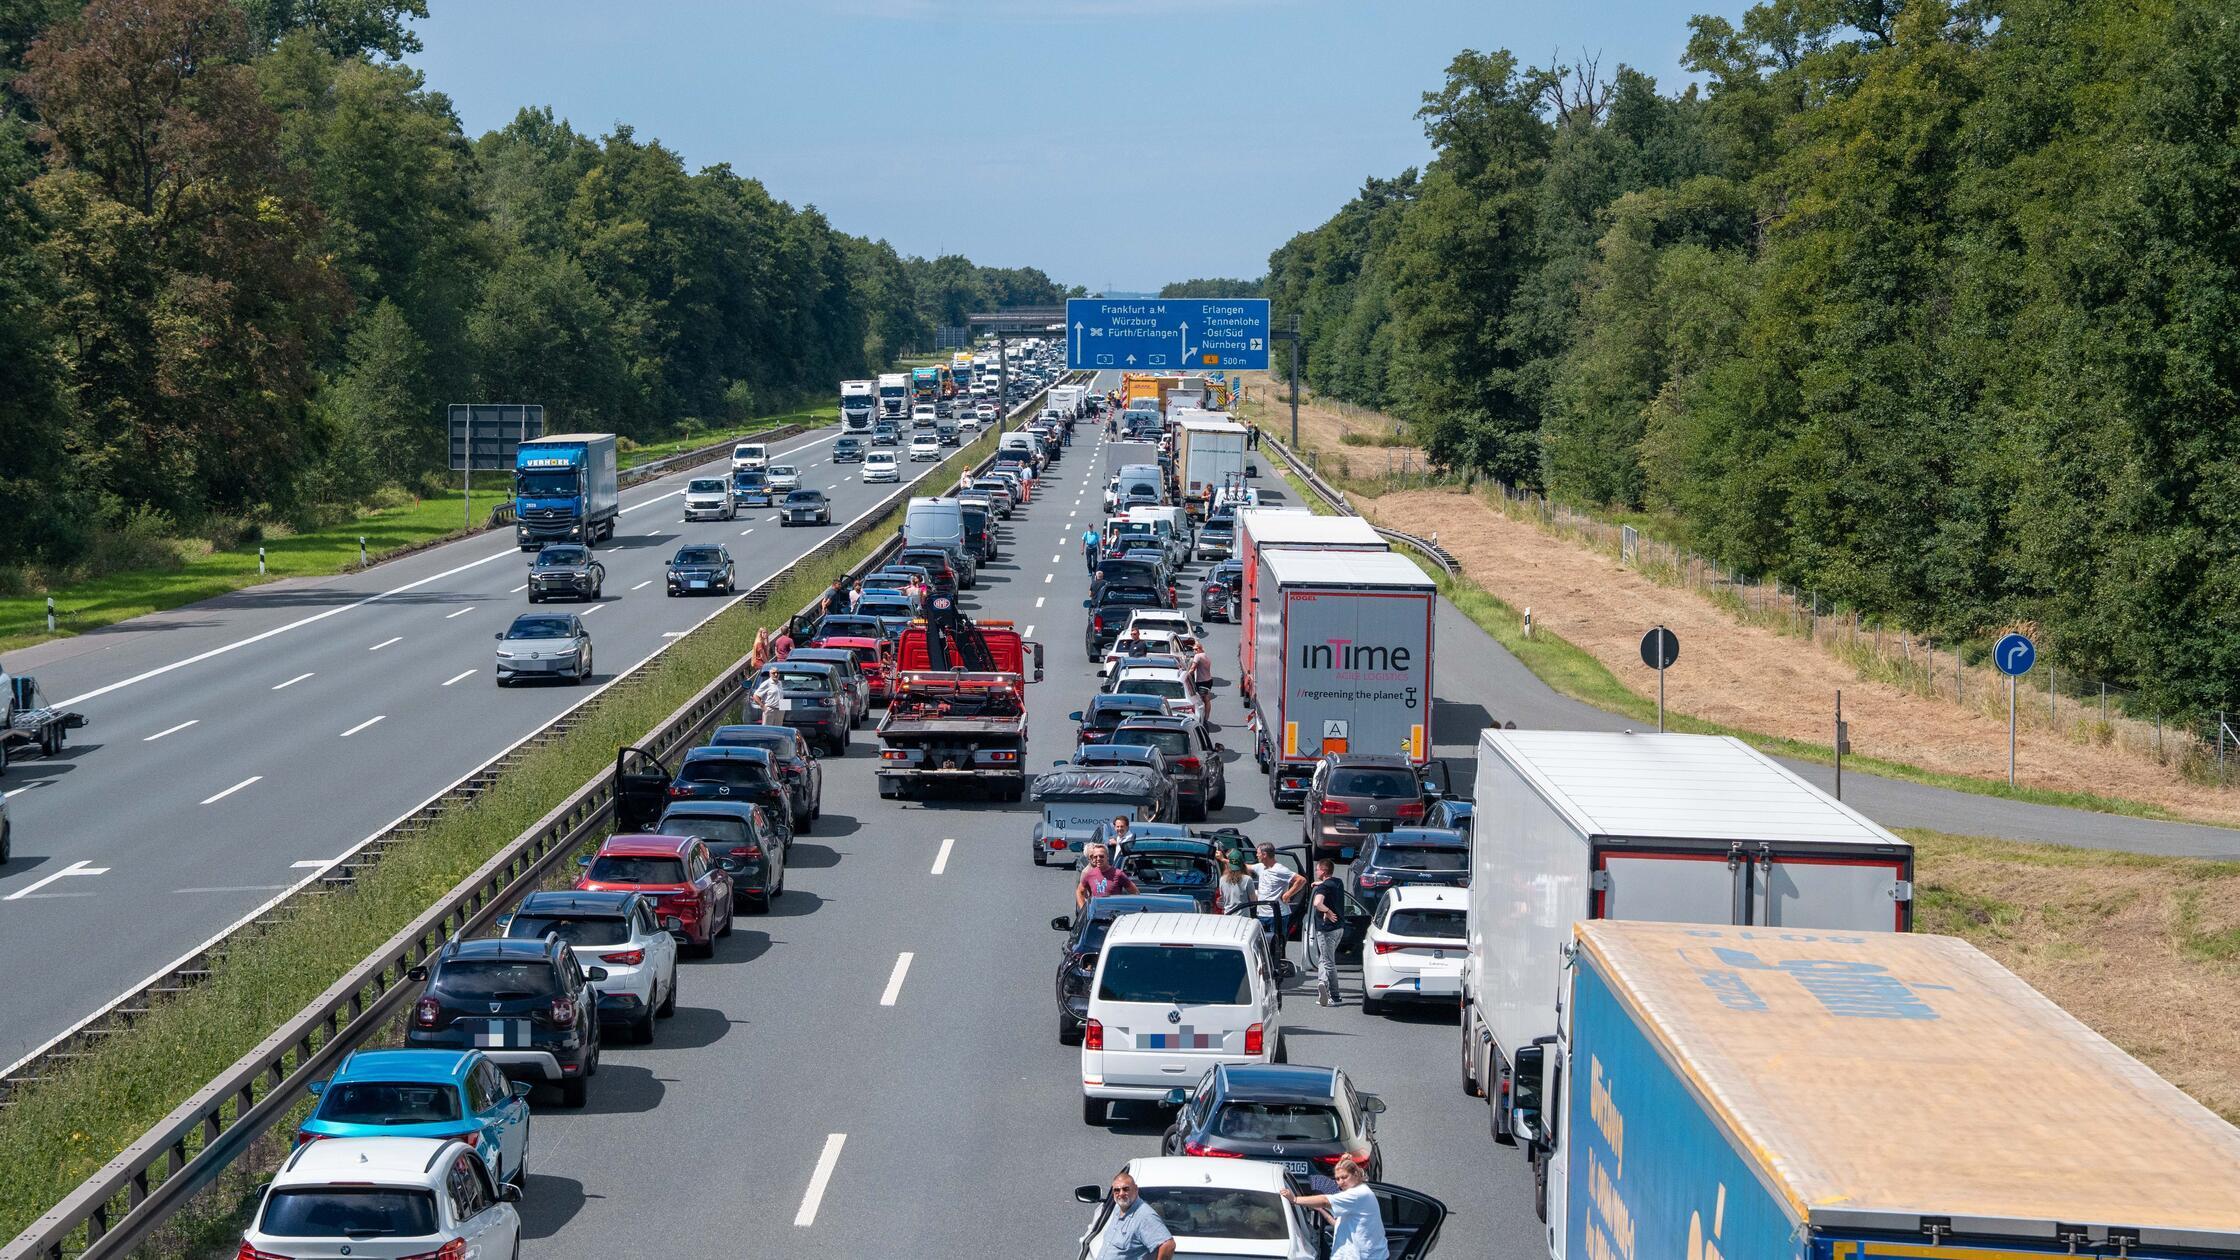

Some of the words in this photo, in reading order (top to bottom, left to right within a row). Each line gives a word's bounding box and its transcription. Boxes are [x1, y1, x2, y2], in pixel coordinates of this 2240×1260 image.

[1101, 305, 1145, 314] Frankfurt
[1150, 305, 1167, 314] a.M.
[1202, 305, 1244, 315] Erlangen
[1112, 316, 1157, 327] Würzburg
[1202, 317, 1260, 326] -Tennenlohe
[1108, 328, 1178, 338] Fürth/Erlangen
[1202, 328, 1243, 338] -Ost/Süd
[1202, 340, 1246, 351] Nürnberg
[1103, 355, 1108, 363] 3
[1155, 355, 1160, 363] 3
[1223, 357, 1238, 365] 500
[1302, 639, 1411, 671] inTime
[1363, 673, 1409, 682] LOGISTICS
[1355, 690, 1372, 700] the
[1373, 690, 1404, 702] planet
[1330, 723, 1342, 736] A
